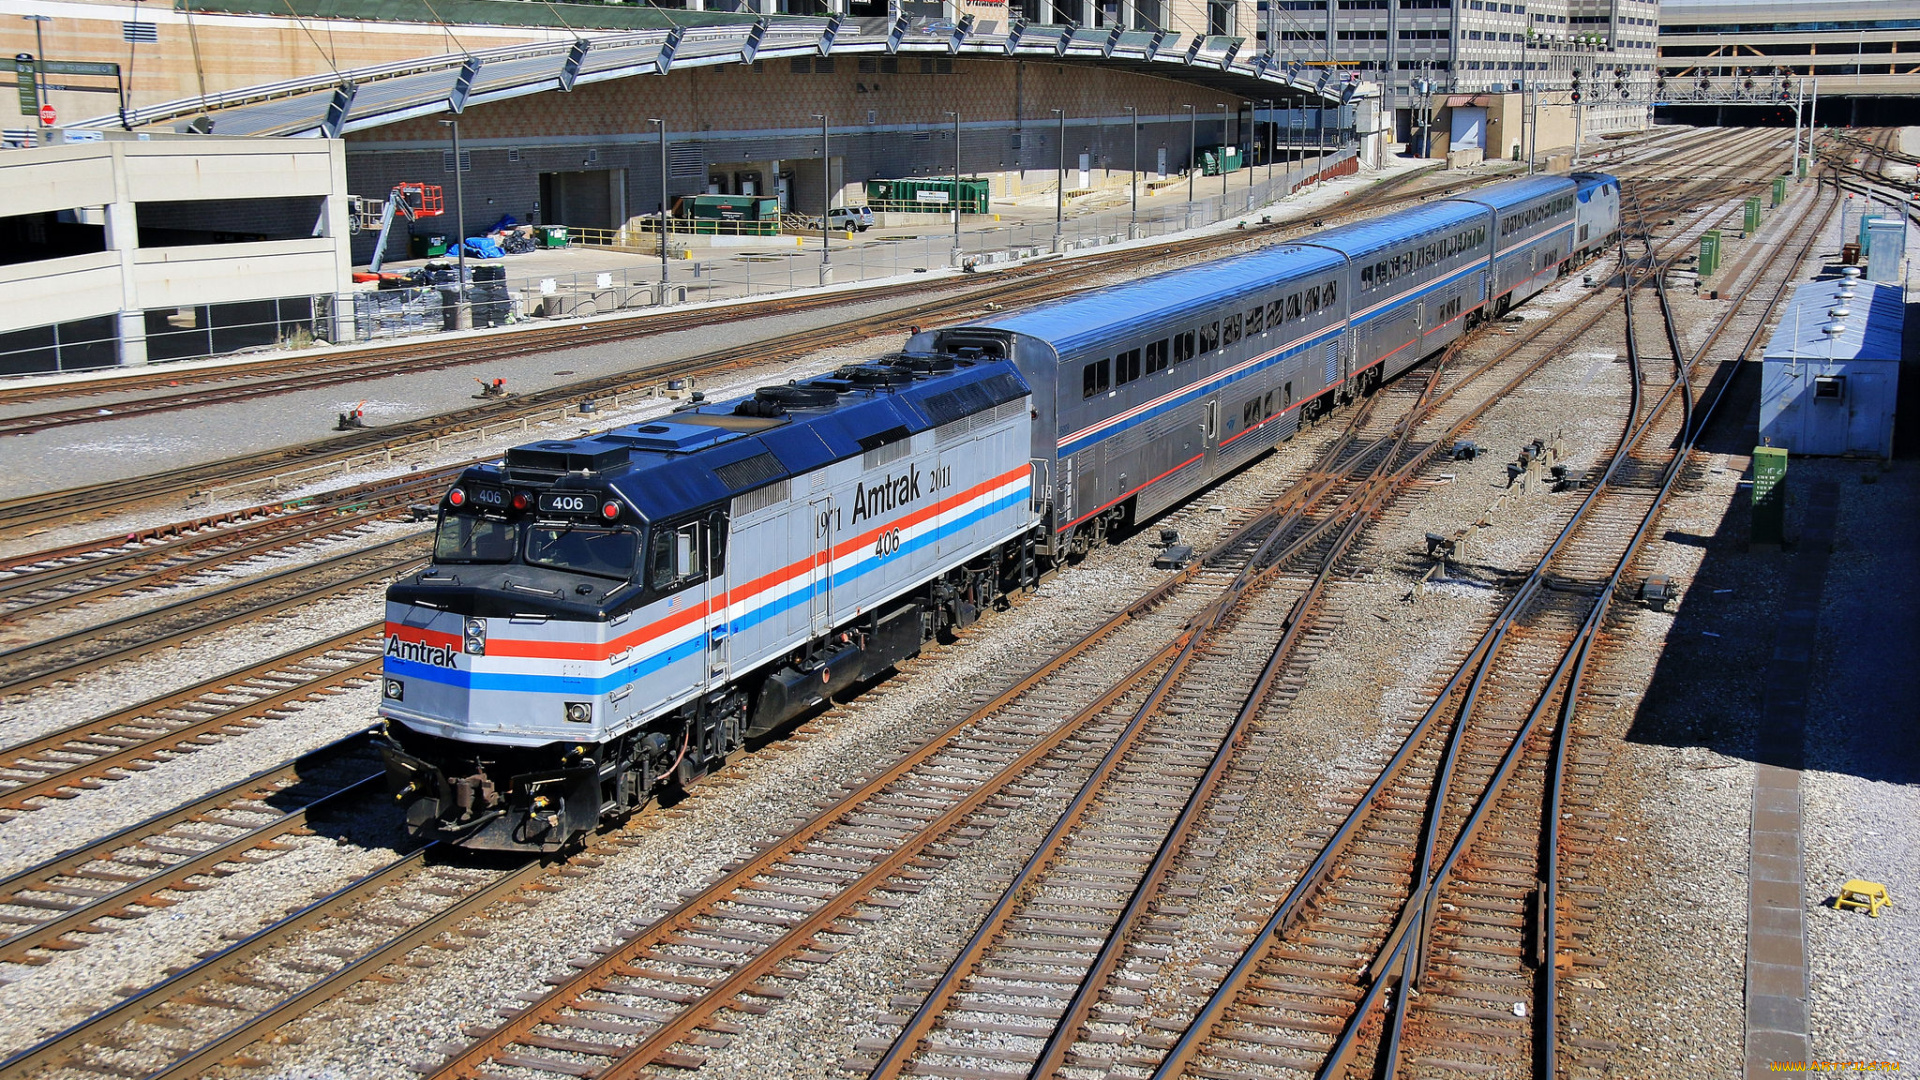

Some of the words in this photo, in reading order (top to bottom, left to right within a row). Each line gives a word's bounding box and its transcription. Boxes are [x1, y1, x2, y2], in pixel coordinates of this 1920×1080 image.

[479, 491, 501, 504] 406
[552, 497, 583, 510] 406
[851, 463, 920, 525] Amtrak
[929, 466, 951, 493] 2011
[875, 527, 900, 559] 406
[386, 634, 457, 669] Amtrak
